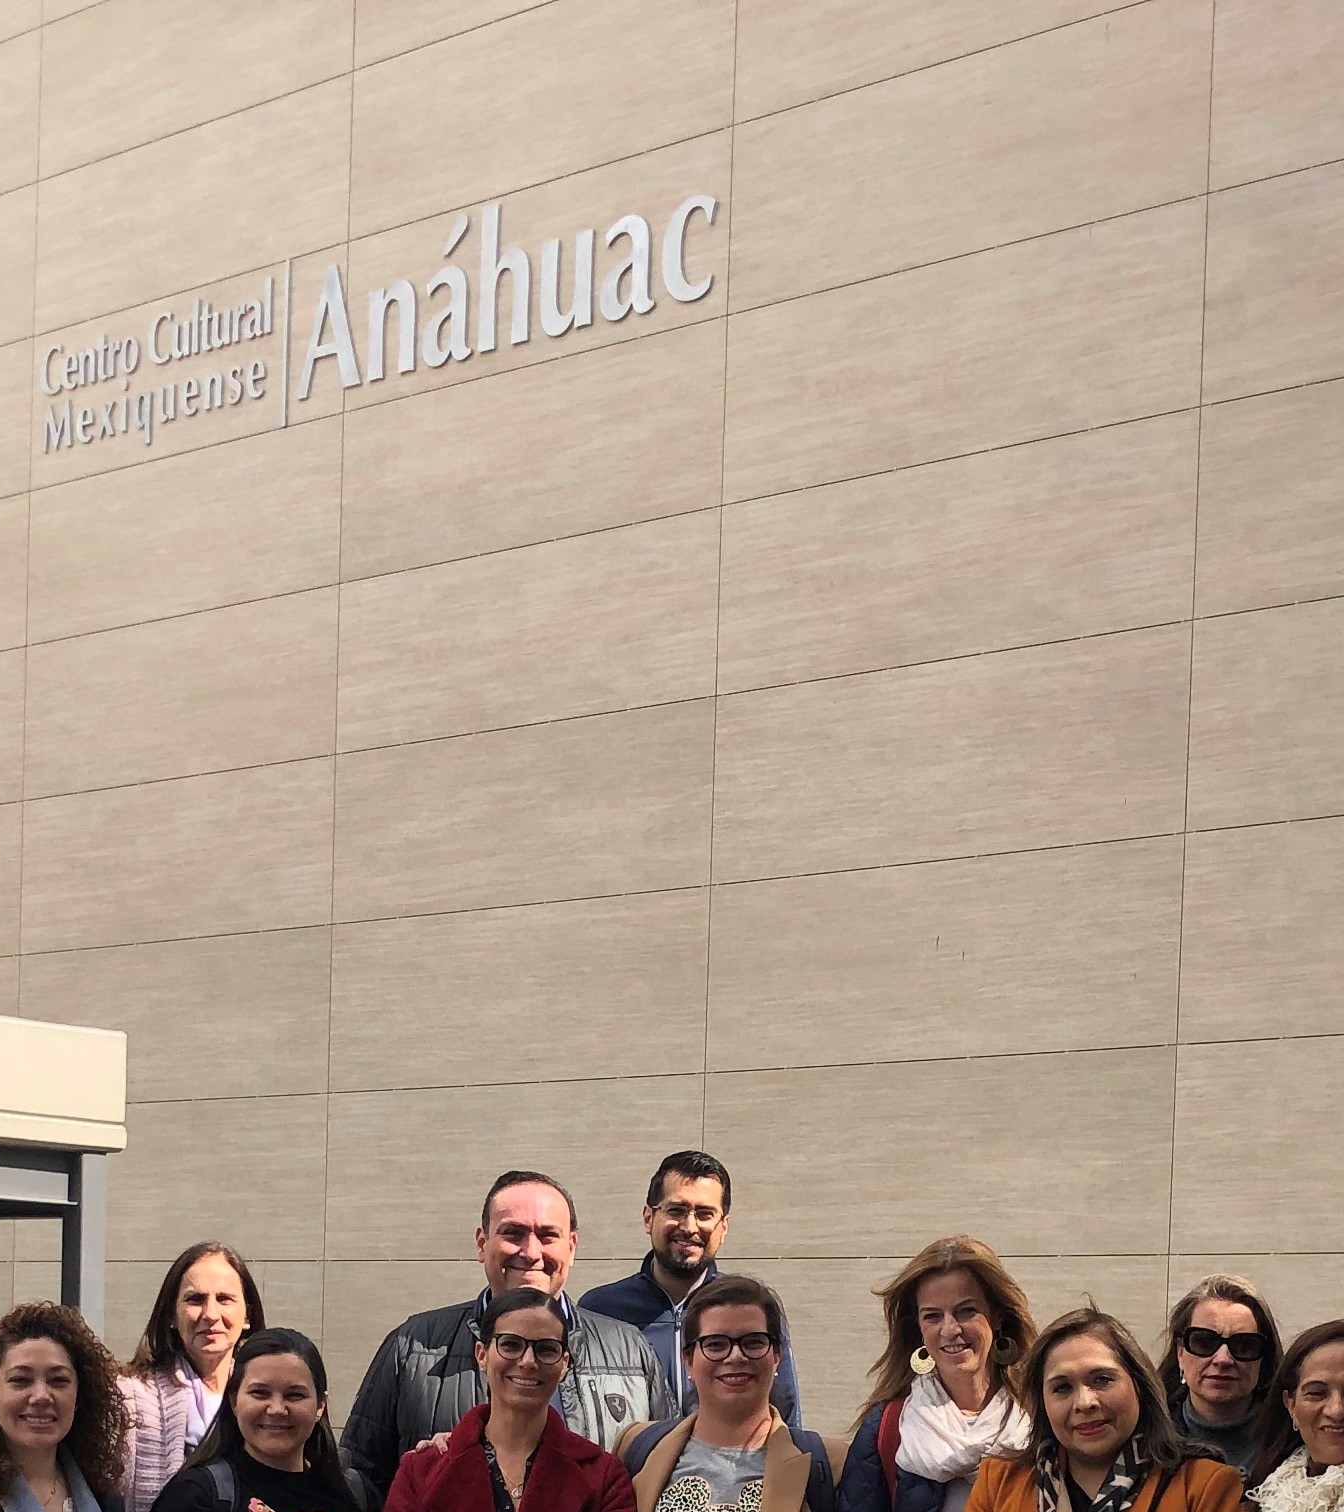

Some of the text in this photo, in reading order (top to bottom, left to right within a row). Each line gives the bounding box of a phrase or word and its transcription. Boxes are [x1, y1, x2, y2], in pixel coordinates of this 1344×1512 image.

[40, 275, 274, 397] Centro Cultural
[297, 194, 717, 400] Anáhuac
[43, 357, 267, 451] Mexiquense
